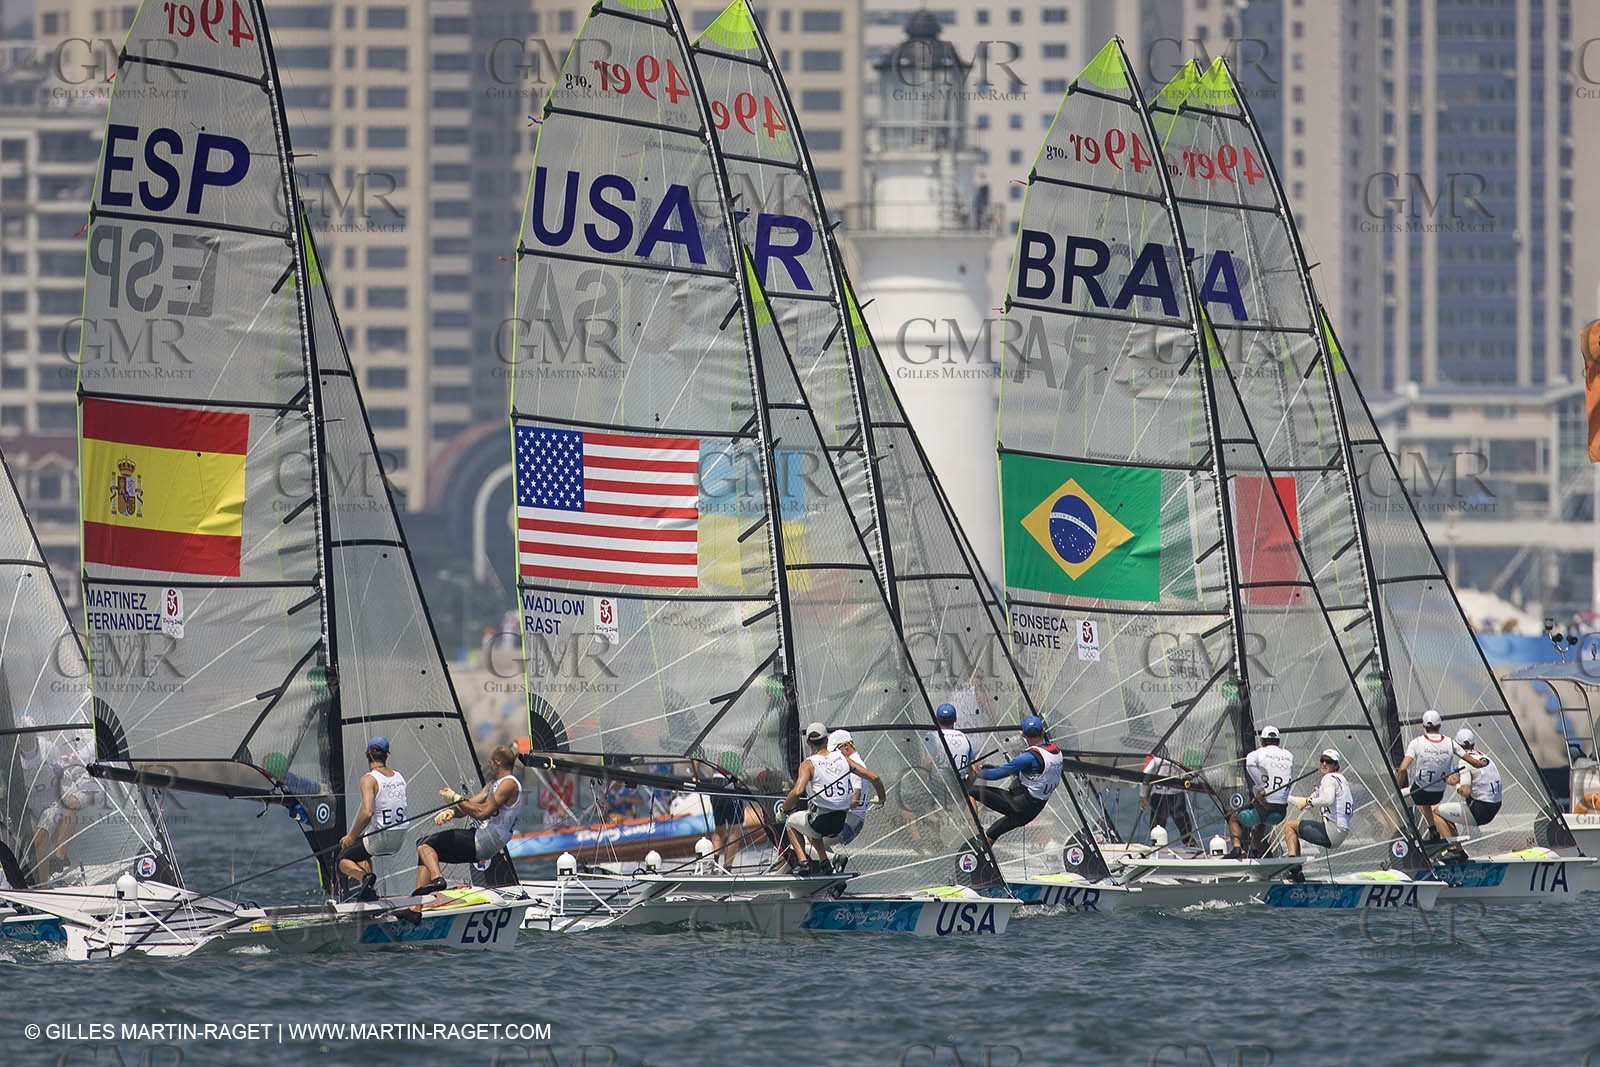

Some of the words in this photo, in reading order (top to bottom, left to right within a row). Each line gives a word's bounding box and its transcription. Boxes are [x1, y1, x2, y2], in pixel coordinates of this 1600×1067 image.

[101, 124, 250, 214] ESP
[532, 166, 706, 265] USA
[1017, 229, 1180, 318] BRA
[86, 590, 147, 610] MARTINEZ
[522, 594, 585, 616] WADLOW
[87, 613, 162, 631] FERNANDEZ
[525, 615, 561, 635] RAST
[1012, 613, 1068, 632] FONSECA
[1014, 631, 1061, 650] DUARTE
[824, 779, 853, 797] USA
[1530, 862, 1568, 893] ITA
[461, 908, 512, 944] ESP
[936, 903, 996, 936] USA
